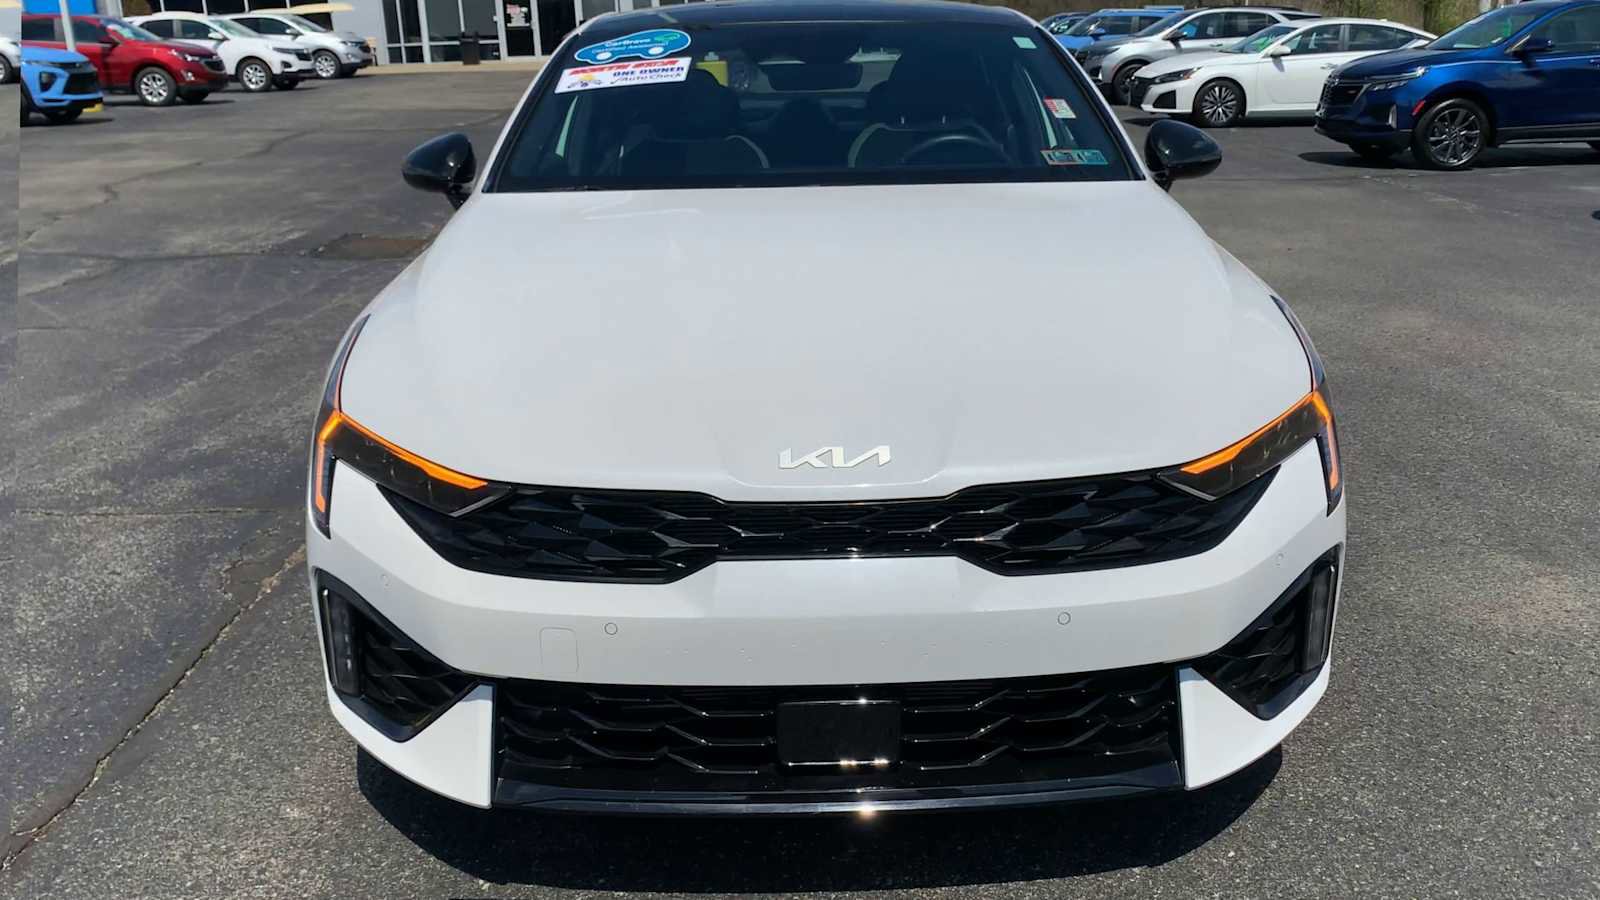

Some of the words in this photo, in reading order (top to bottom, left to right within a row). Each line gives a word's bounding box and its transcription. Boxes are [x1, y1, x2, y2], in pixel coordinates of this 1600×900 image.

[613, 69, 635, 77] ONE
[639, 66, 685, 74] OWNER
[779, 446, 891, 469] KIA
